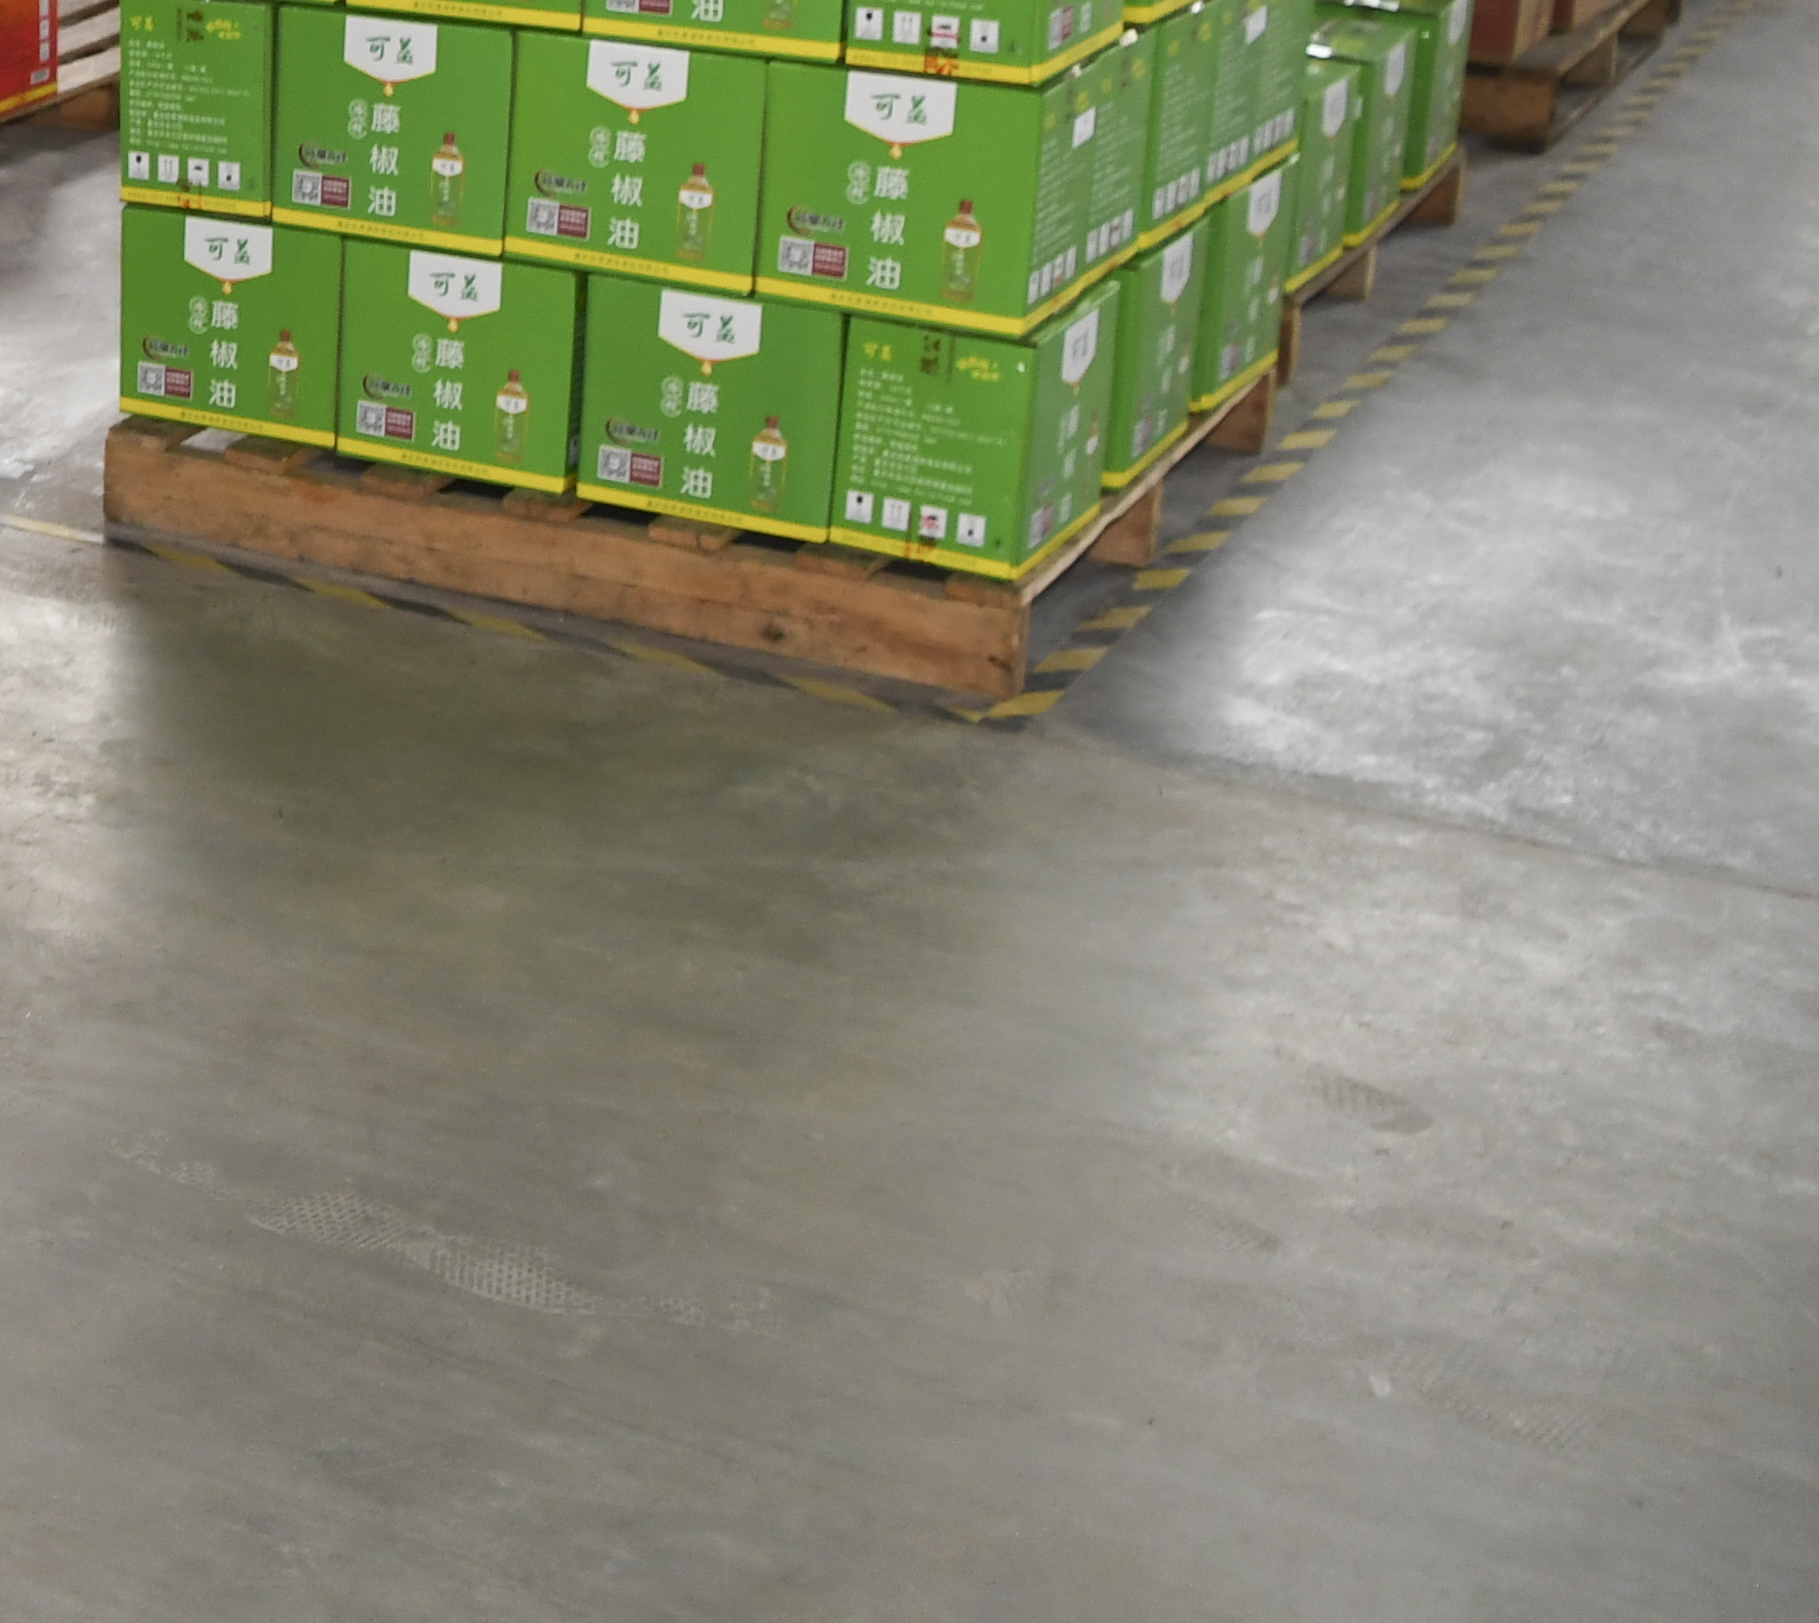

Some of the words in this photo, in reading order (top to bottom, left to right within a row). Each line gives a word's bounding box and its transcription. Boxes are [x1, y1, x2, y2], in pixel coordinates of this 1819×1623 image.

[366, 38, 414, 65] 可益
[611, 62, 662, 91] 可益
[871, 94, 927, 125] 可益
[367, 102, 401, 217] 藤椒油
[607, 130, 647, 250] 藤椒油
[204, 237, 250, 264] 可益
[865, 165, 909, 290] 藤椒油
[429, 273, 478, 302] 可益
[209, 302, 239, 409] 藤椒油
[683, 312, 735, 343] 可益
[432, 338, 465, 451] 藤椒油
[681, 382, 719, 499] 藤椒油
